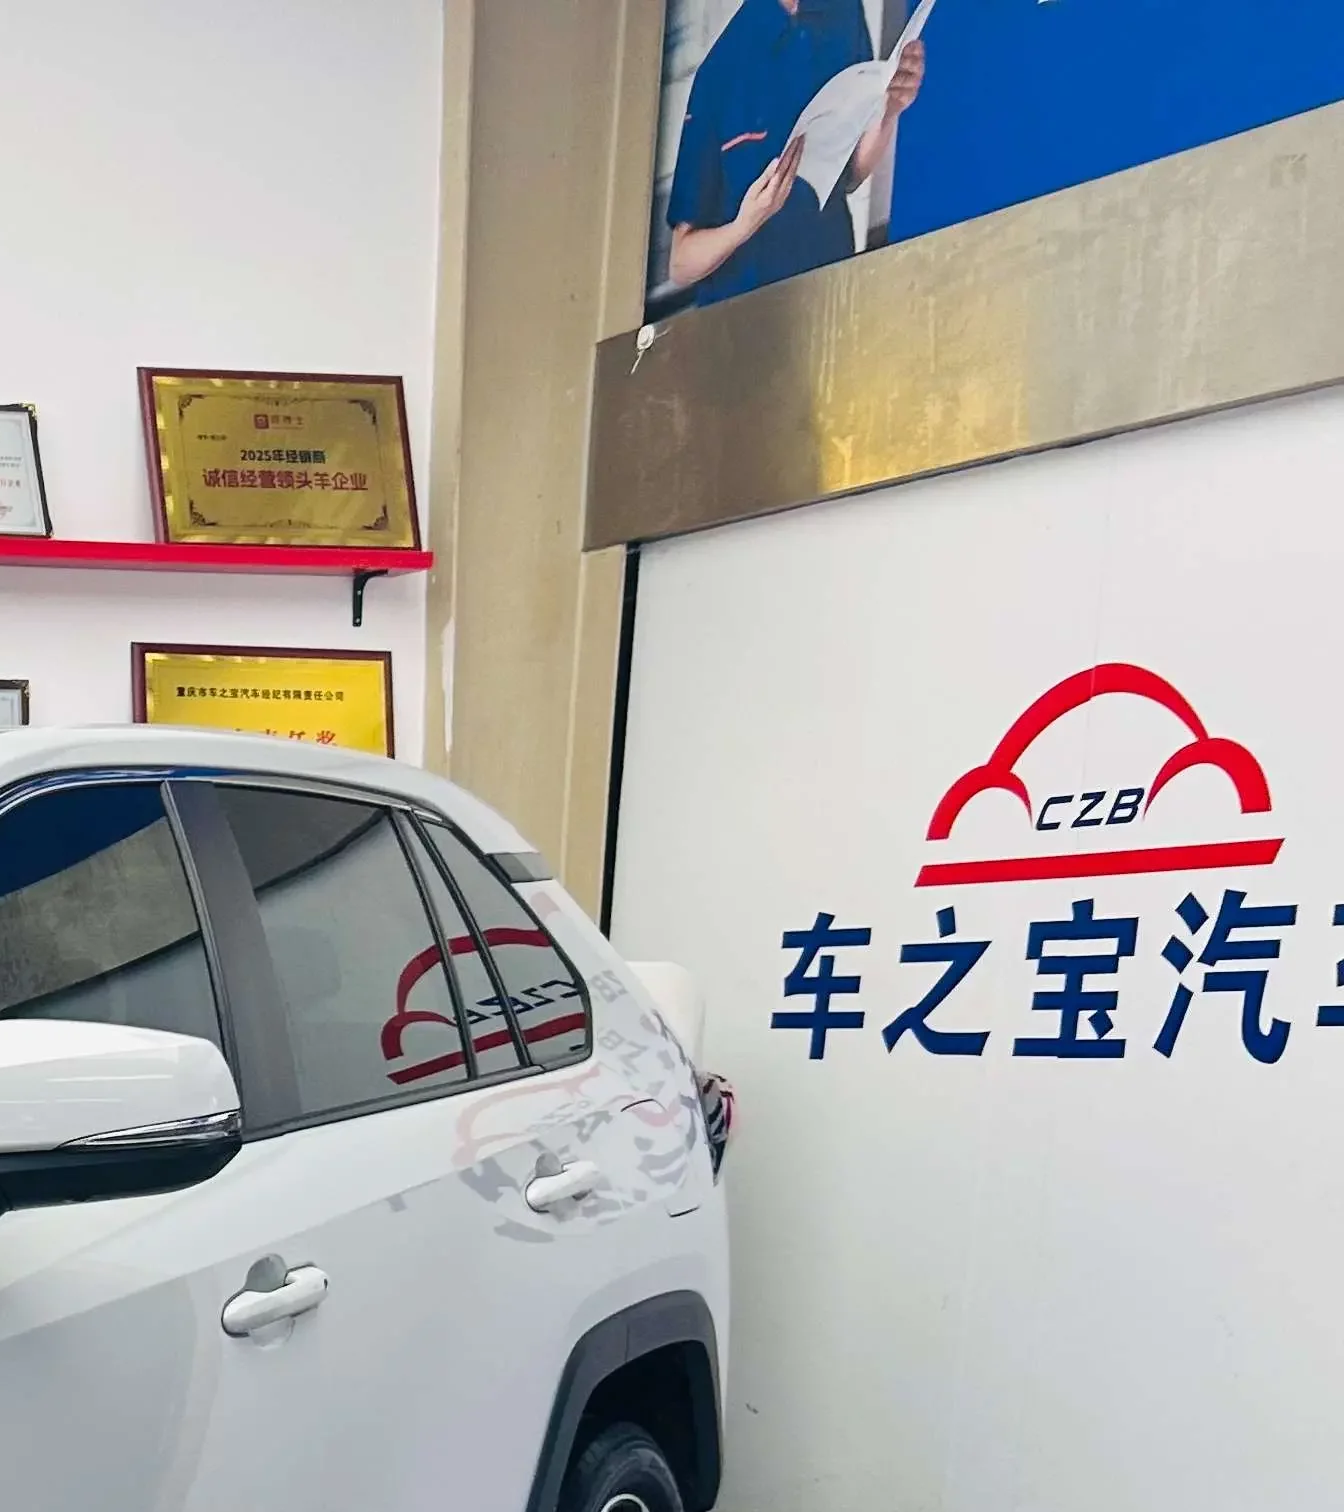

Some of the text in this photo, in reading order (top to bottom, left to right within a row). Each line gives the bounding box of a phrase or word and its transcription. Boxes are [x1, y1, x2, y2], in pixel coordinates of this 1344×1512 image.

[202, 468, 369, 490] 诚信经营领头羊企业
[176, 686, 344, 701] 重庆市车之宝汽车经纪有限责任公司
[1034, 787, 1146, 831] CZB
